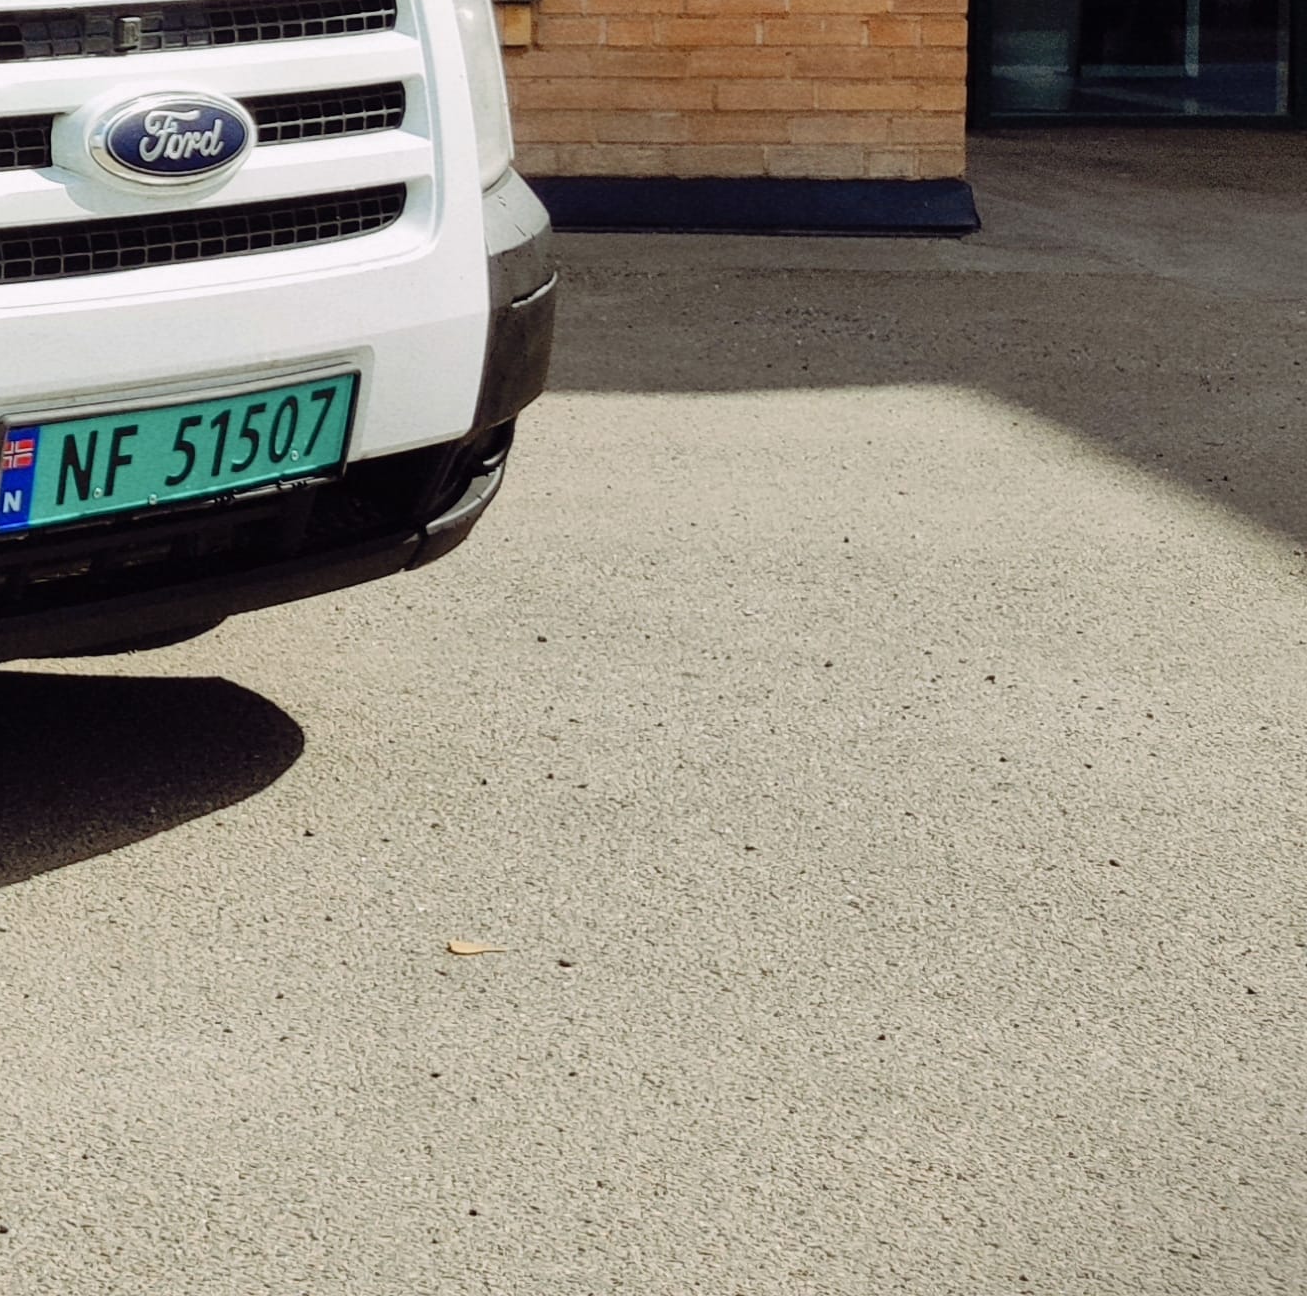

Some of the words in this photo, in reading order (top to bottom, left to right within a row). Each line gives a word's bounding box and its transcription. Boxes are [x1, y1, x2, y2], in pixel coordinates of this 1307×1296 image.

[138, 108, 225, 163] Ford
[55, 424, 139, 506] NF
[165, 386, 337, 487] 51507
[2, 489, 22, 514] N
